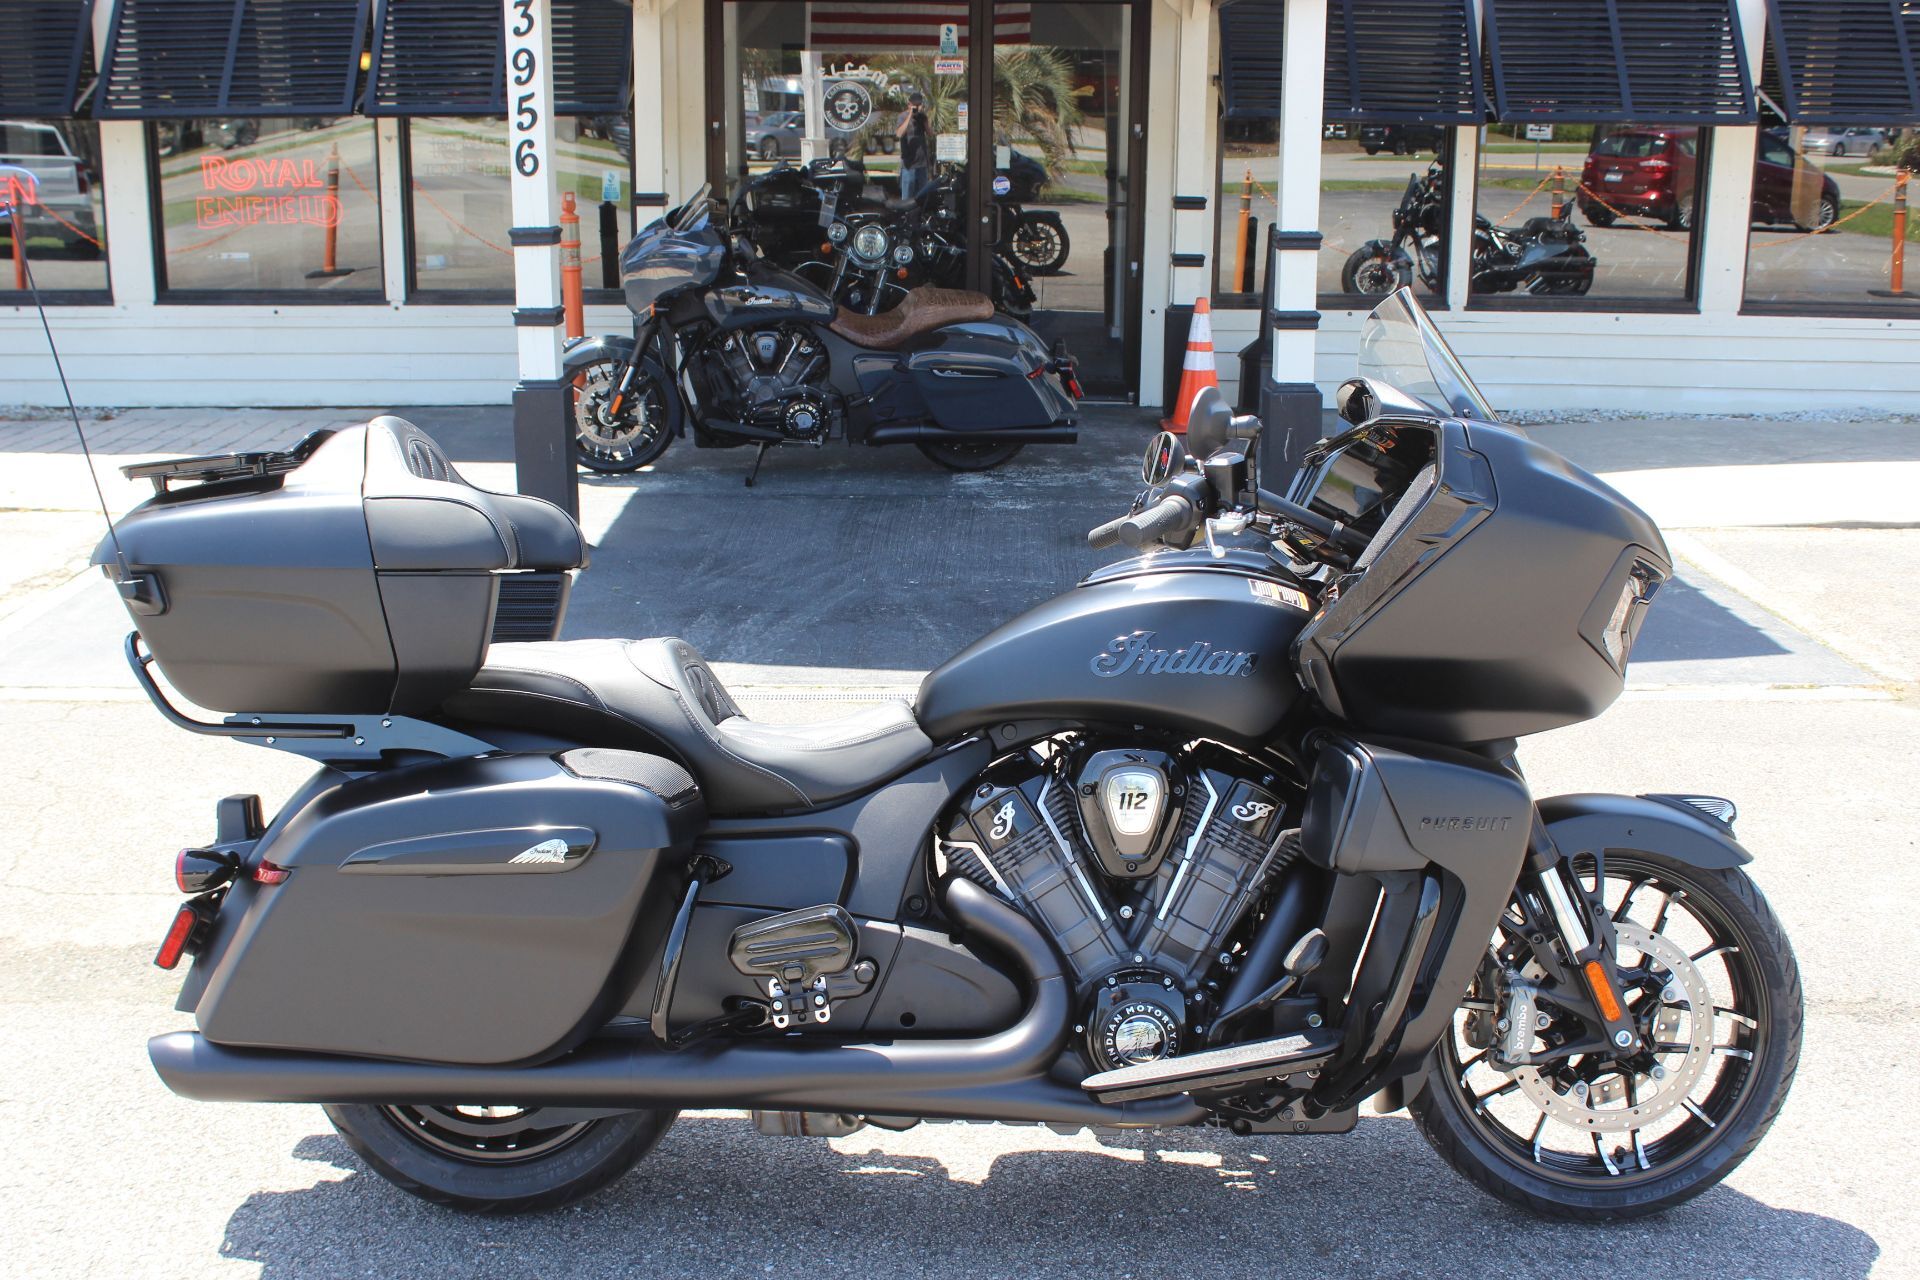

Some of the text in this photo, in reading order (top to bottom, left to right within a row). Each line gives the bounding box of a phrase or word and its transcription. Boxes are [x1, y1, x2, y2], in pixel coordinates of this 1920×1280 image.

[512, 0, 540, 177] 3956
[745, 296, 773, 306] Indian
[1090, 631, 1259, 678] Indian
[1119, 792, 1148, 809] 112
[1419, 816, 1512, 831] PURSUIT
[1106, 1013, 1123, 1062] INDIAN
[1514, 1005, 1527, 1050] brembo
